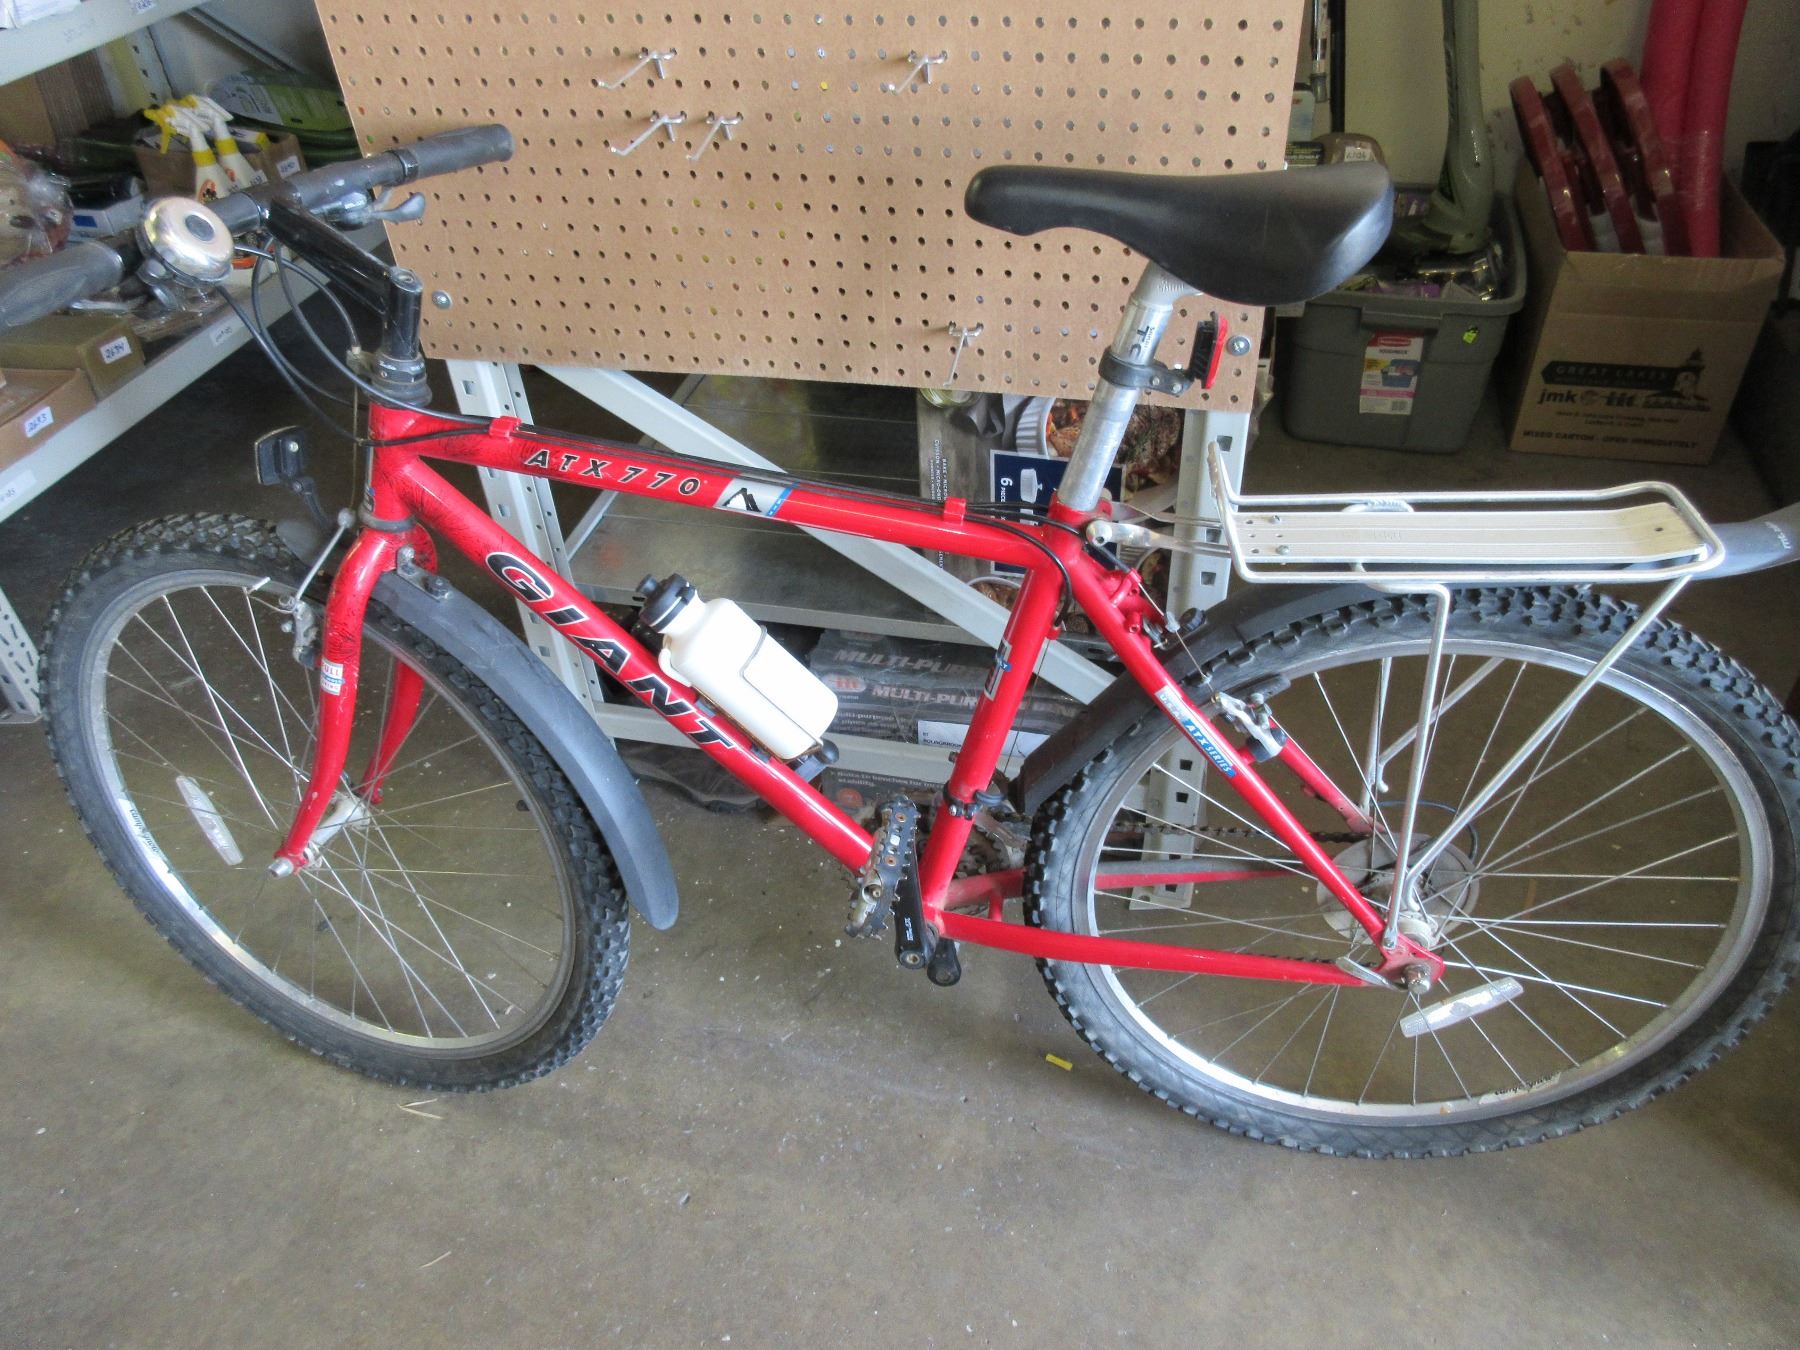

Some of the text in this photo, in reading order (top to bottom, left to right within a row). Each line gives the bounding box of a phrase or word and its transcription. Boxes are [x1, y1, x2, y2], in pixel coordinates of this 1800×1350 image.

[1537, 388, 1577, 404] jmk
[525, 449, 702, 496] ATX 770
[1000, 477, 1013, 487] 6
[486, 551, 735, 750] GIANT
[1186, 723, 1232, 773] ATX SERIES
